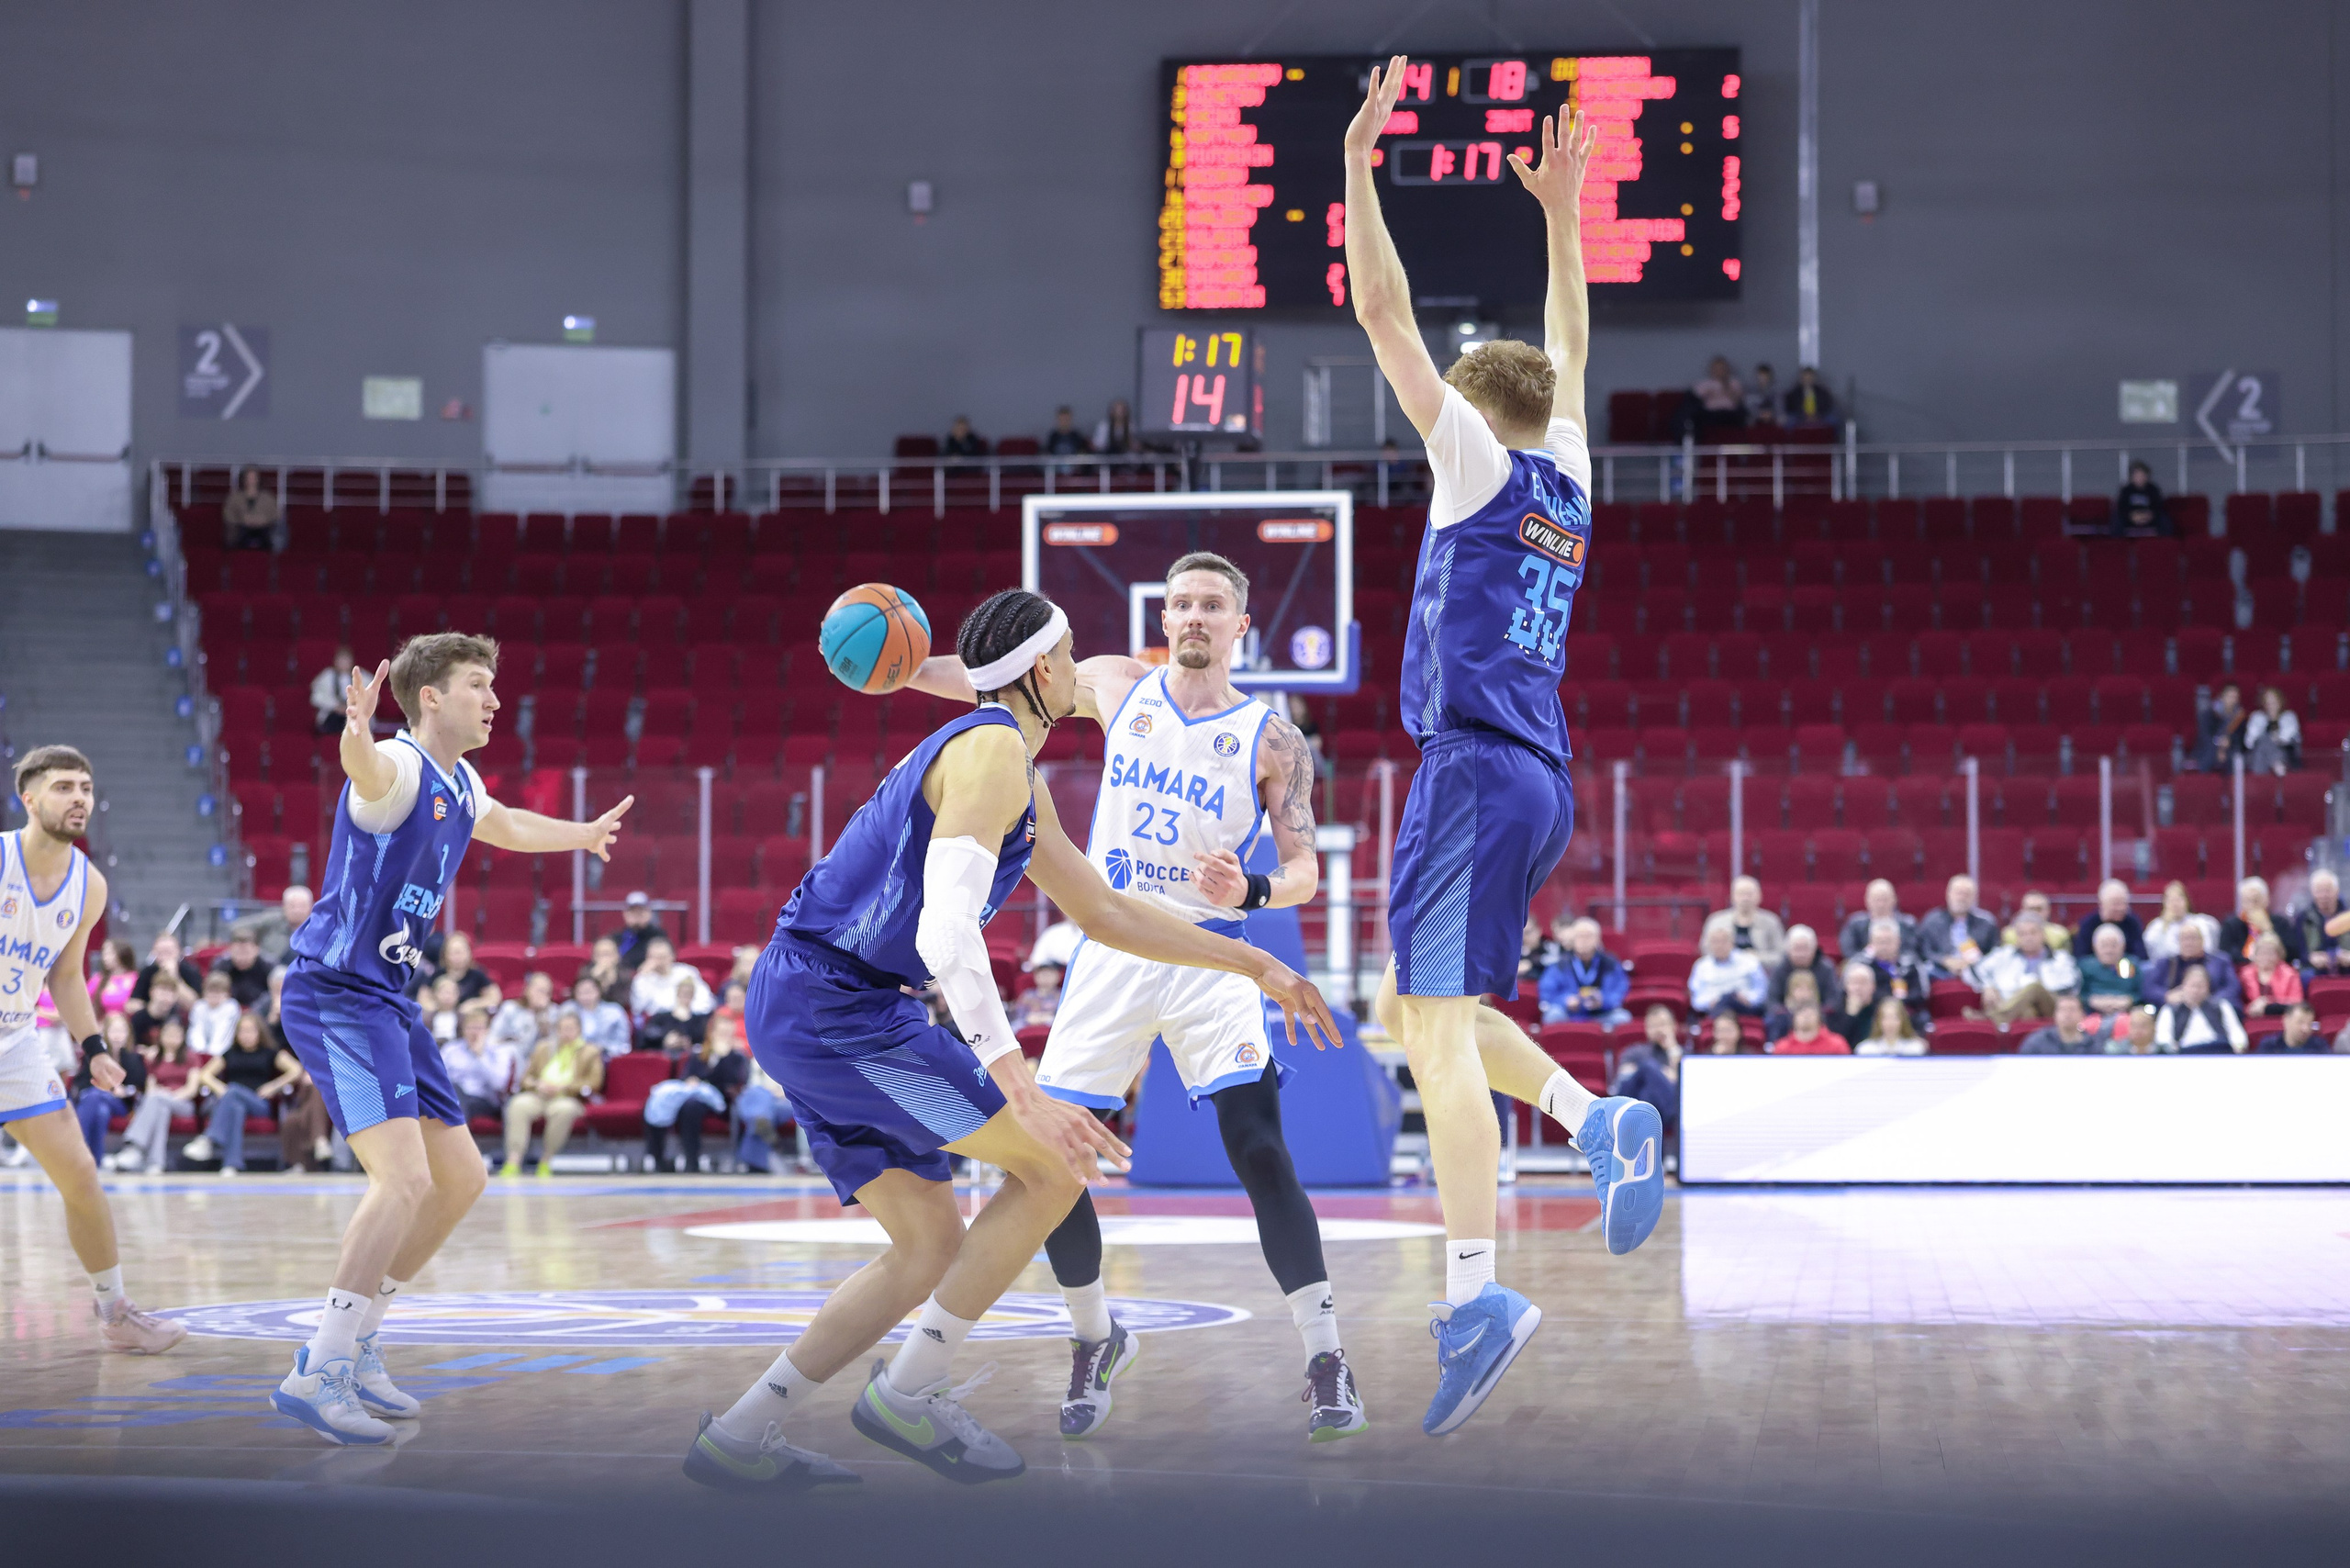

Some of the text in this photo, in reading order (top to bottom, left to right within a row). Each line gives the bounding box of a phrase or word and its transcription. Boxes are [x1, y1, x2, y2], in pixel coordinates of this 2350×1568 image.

[1488, 61, 1527, 101] 18
[1430, 141, 1503, 182] 1:17
[196, 330, 221, 375] 2
[1172, 332, 1242, 367] 1:17
[1171, 374, 1226, 425] 14
[2237, 375, 2264, 420] 2
[1508, 554, 1577, 661] 35
[1139, 697, 1163, 708] ZEDO
[1110, 753, 1225, 821] SAMARA
[1131, 801, 1181, 846] 23
[436, 844, 449, 885] 1
[1136, 859, 1193, 882] РОССЕ
[2, 967, 24, 995] 3
